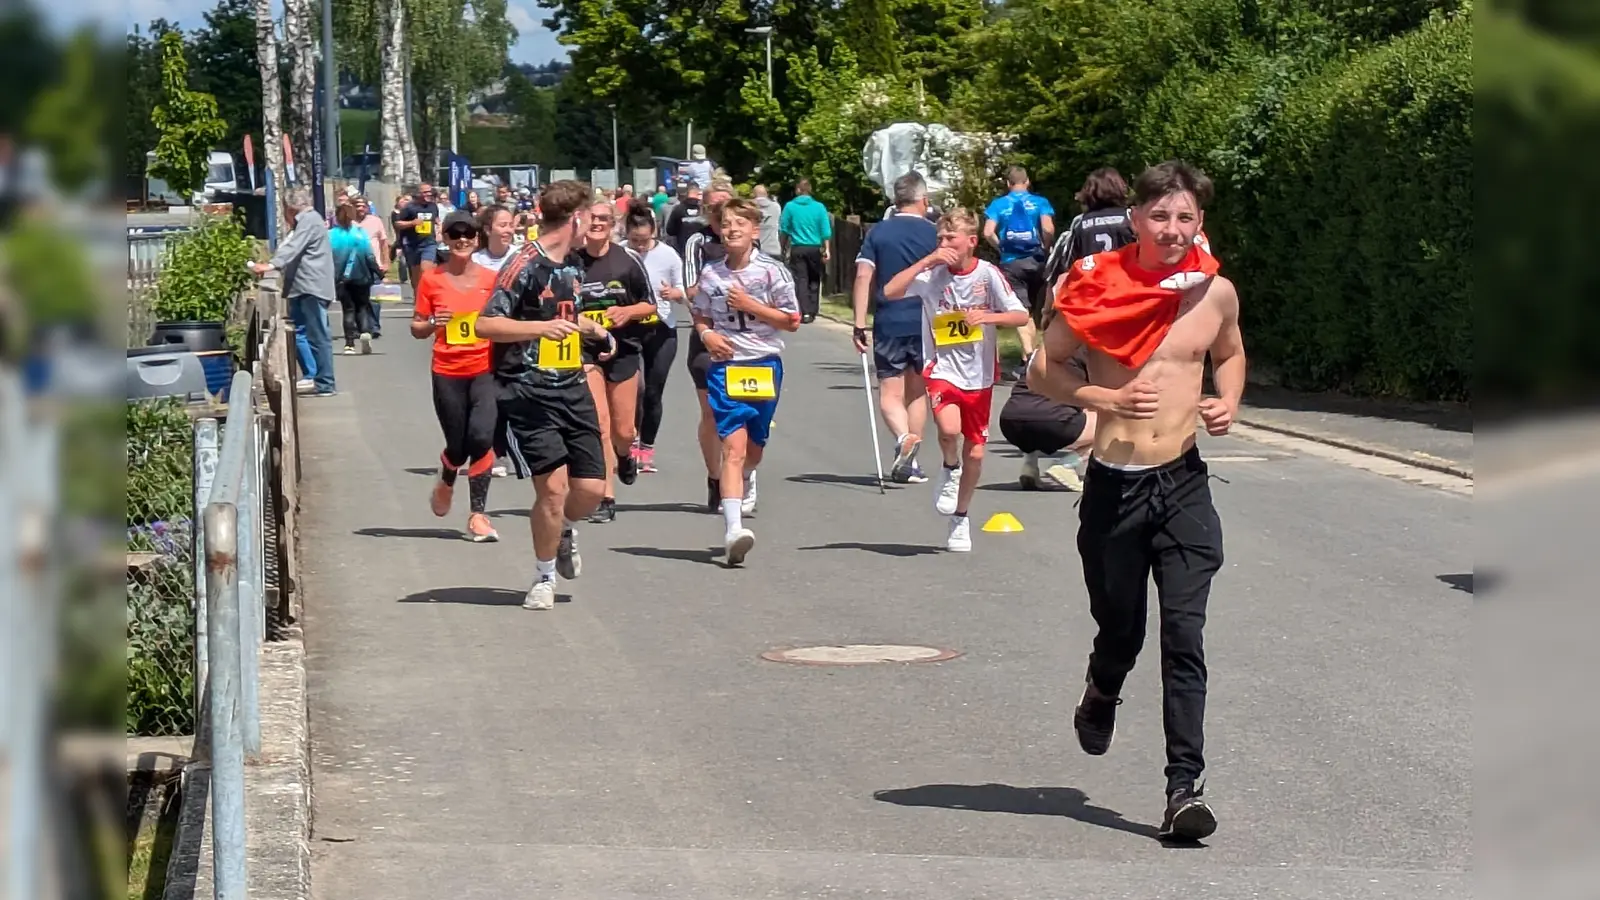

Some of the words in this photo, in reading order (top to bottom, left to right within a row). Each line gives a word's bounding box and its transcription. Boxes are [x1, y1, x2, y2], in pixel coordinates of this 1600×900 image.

[459, 321, 471, 338] 9
[947, 320, 969, 338] 20
[556, 340, 571, 361] 11
[739, 378, 758, 393] 19
